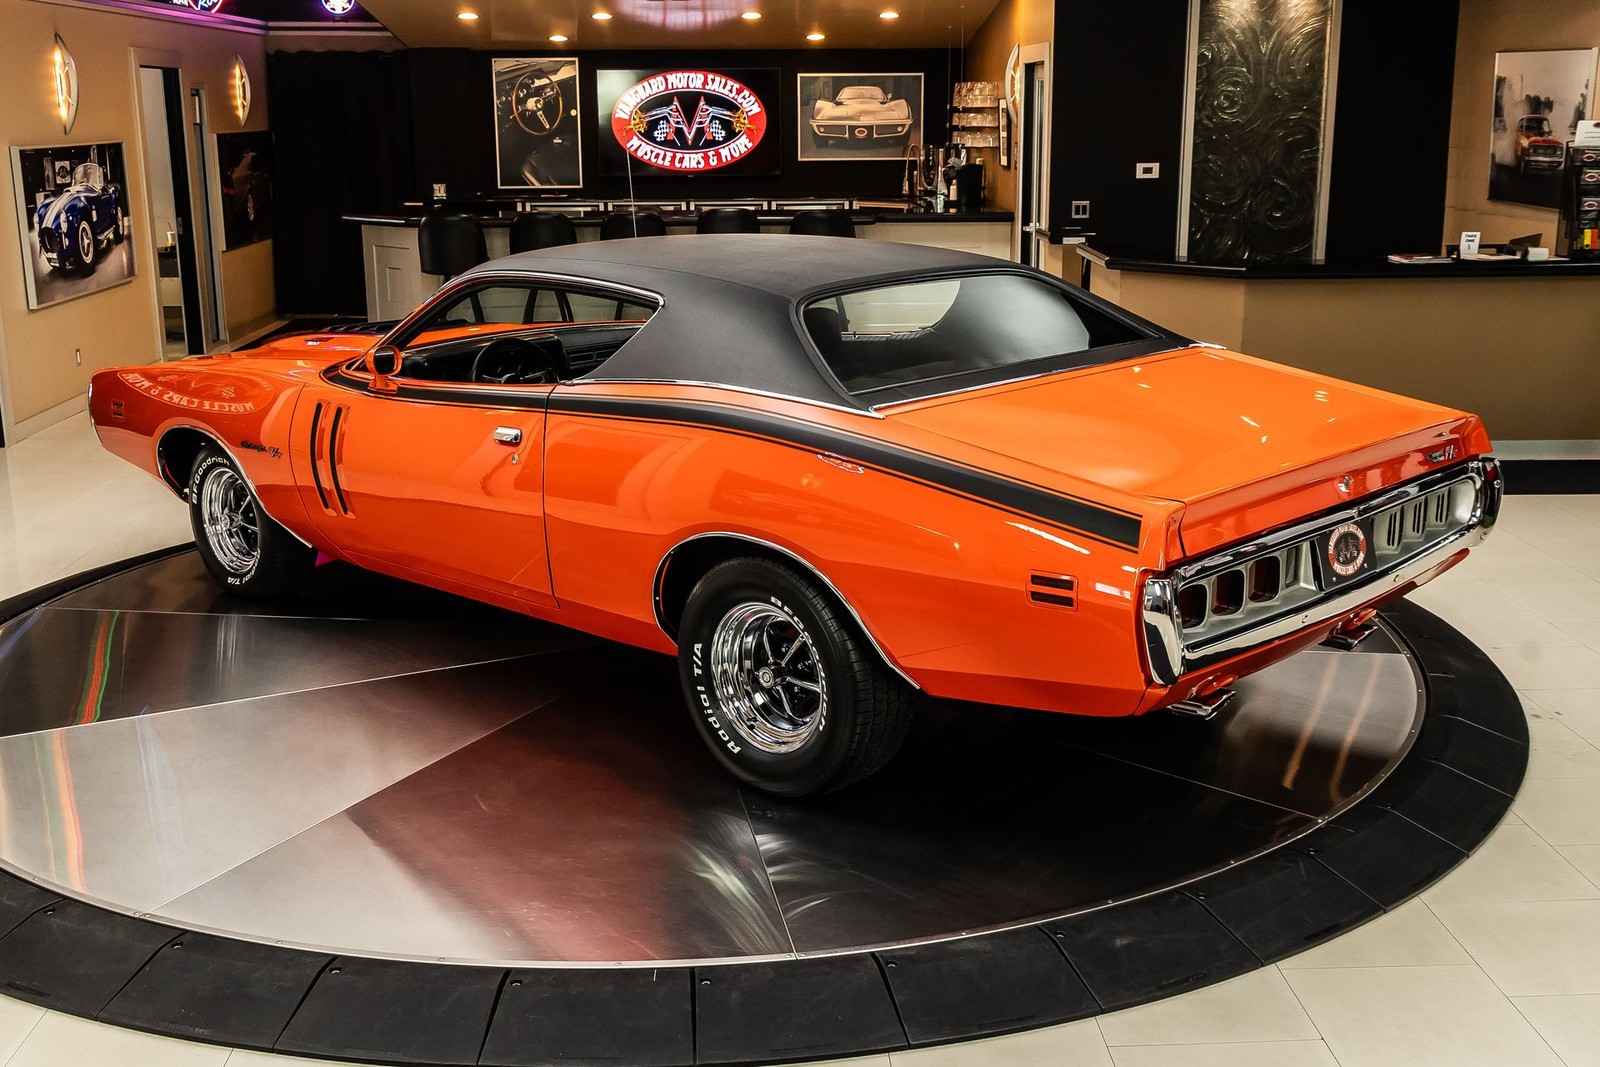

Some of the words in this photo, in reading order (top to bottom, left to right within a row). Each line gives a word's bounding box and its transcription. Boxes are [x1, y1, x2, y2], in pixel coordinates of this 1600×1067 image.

[615, 77, 666, 120] VANGUARD
[666, 72, 704, 90] MOTOR
[705, 73, 762, 116] SALES.COM
[626, 135, 674, 167] MUSCLE
[674, 152, 705, 169] CARS
[708, 150, 718, 166] &
[718, 135, 754, 163] MORE
[191, 455, 230, 505] BFGoodrich
[227, 576, 241, 585] T/A
[692, 642, 703, 677] T/A
[696, 686, 742, 754] Radial
